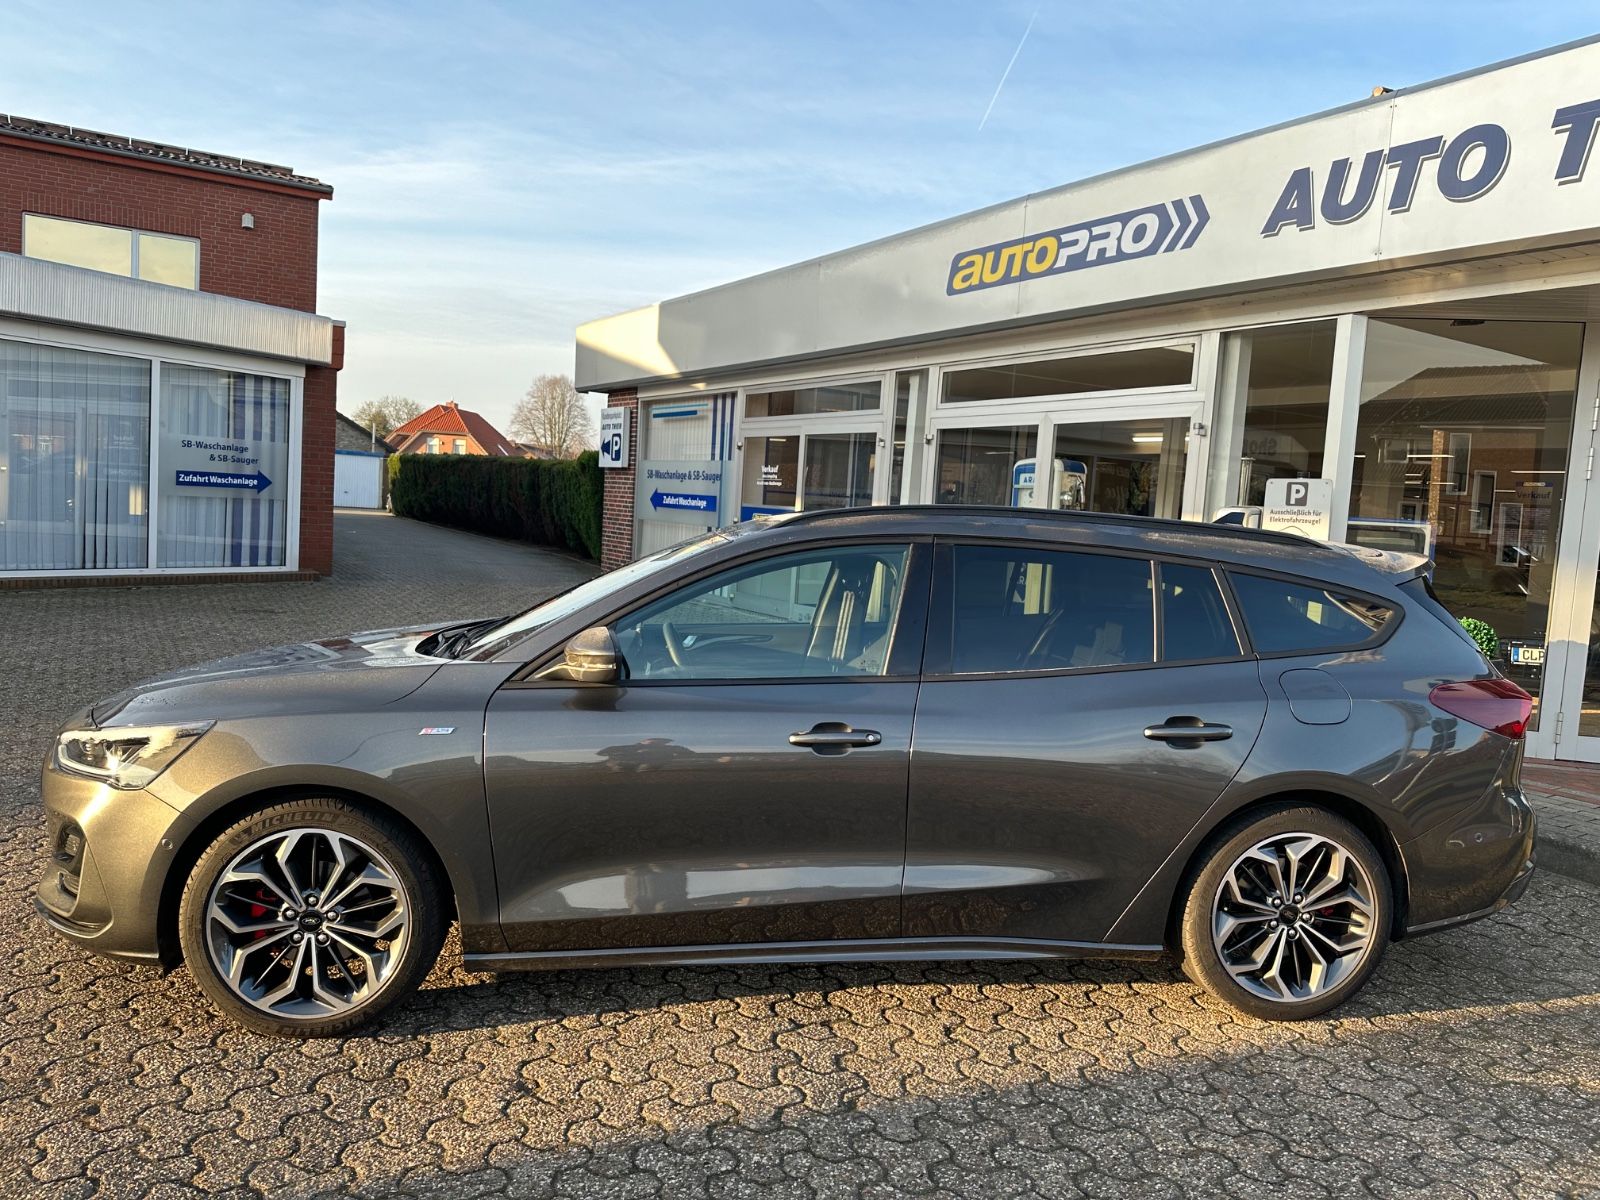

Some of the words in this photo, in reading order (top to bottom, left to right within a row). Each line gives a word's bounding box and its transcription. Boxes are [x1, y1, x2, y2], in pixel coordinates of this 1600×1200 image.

[1260, 123, 1511, 238] AUTO
[1551, 99, 1600, 186] T
[181, 440, 249, 453] SB-Waschanlage
[217, 455, 259, 465] SB-Sauger
[179, 474, 209, 483] Zufahrt
[209, 475, 258, 487] Waschanlage
[647, 469, 687, 482] SB-Waschanlage
[1023, 476, 1034, 484] AR
[1290, 484, 1306, 504] P
[663, 495, 679, 505] Zufahrt
[679, 496, 707, 509] Waschanlage
[251, 811, 334, 835] MICHELIN
